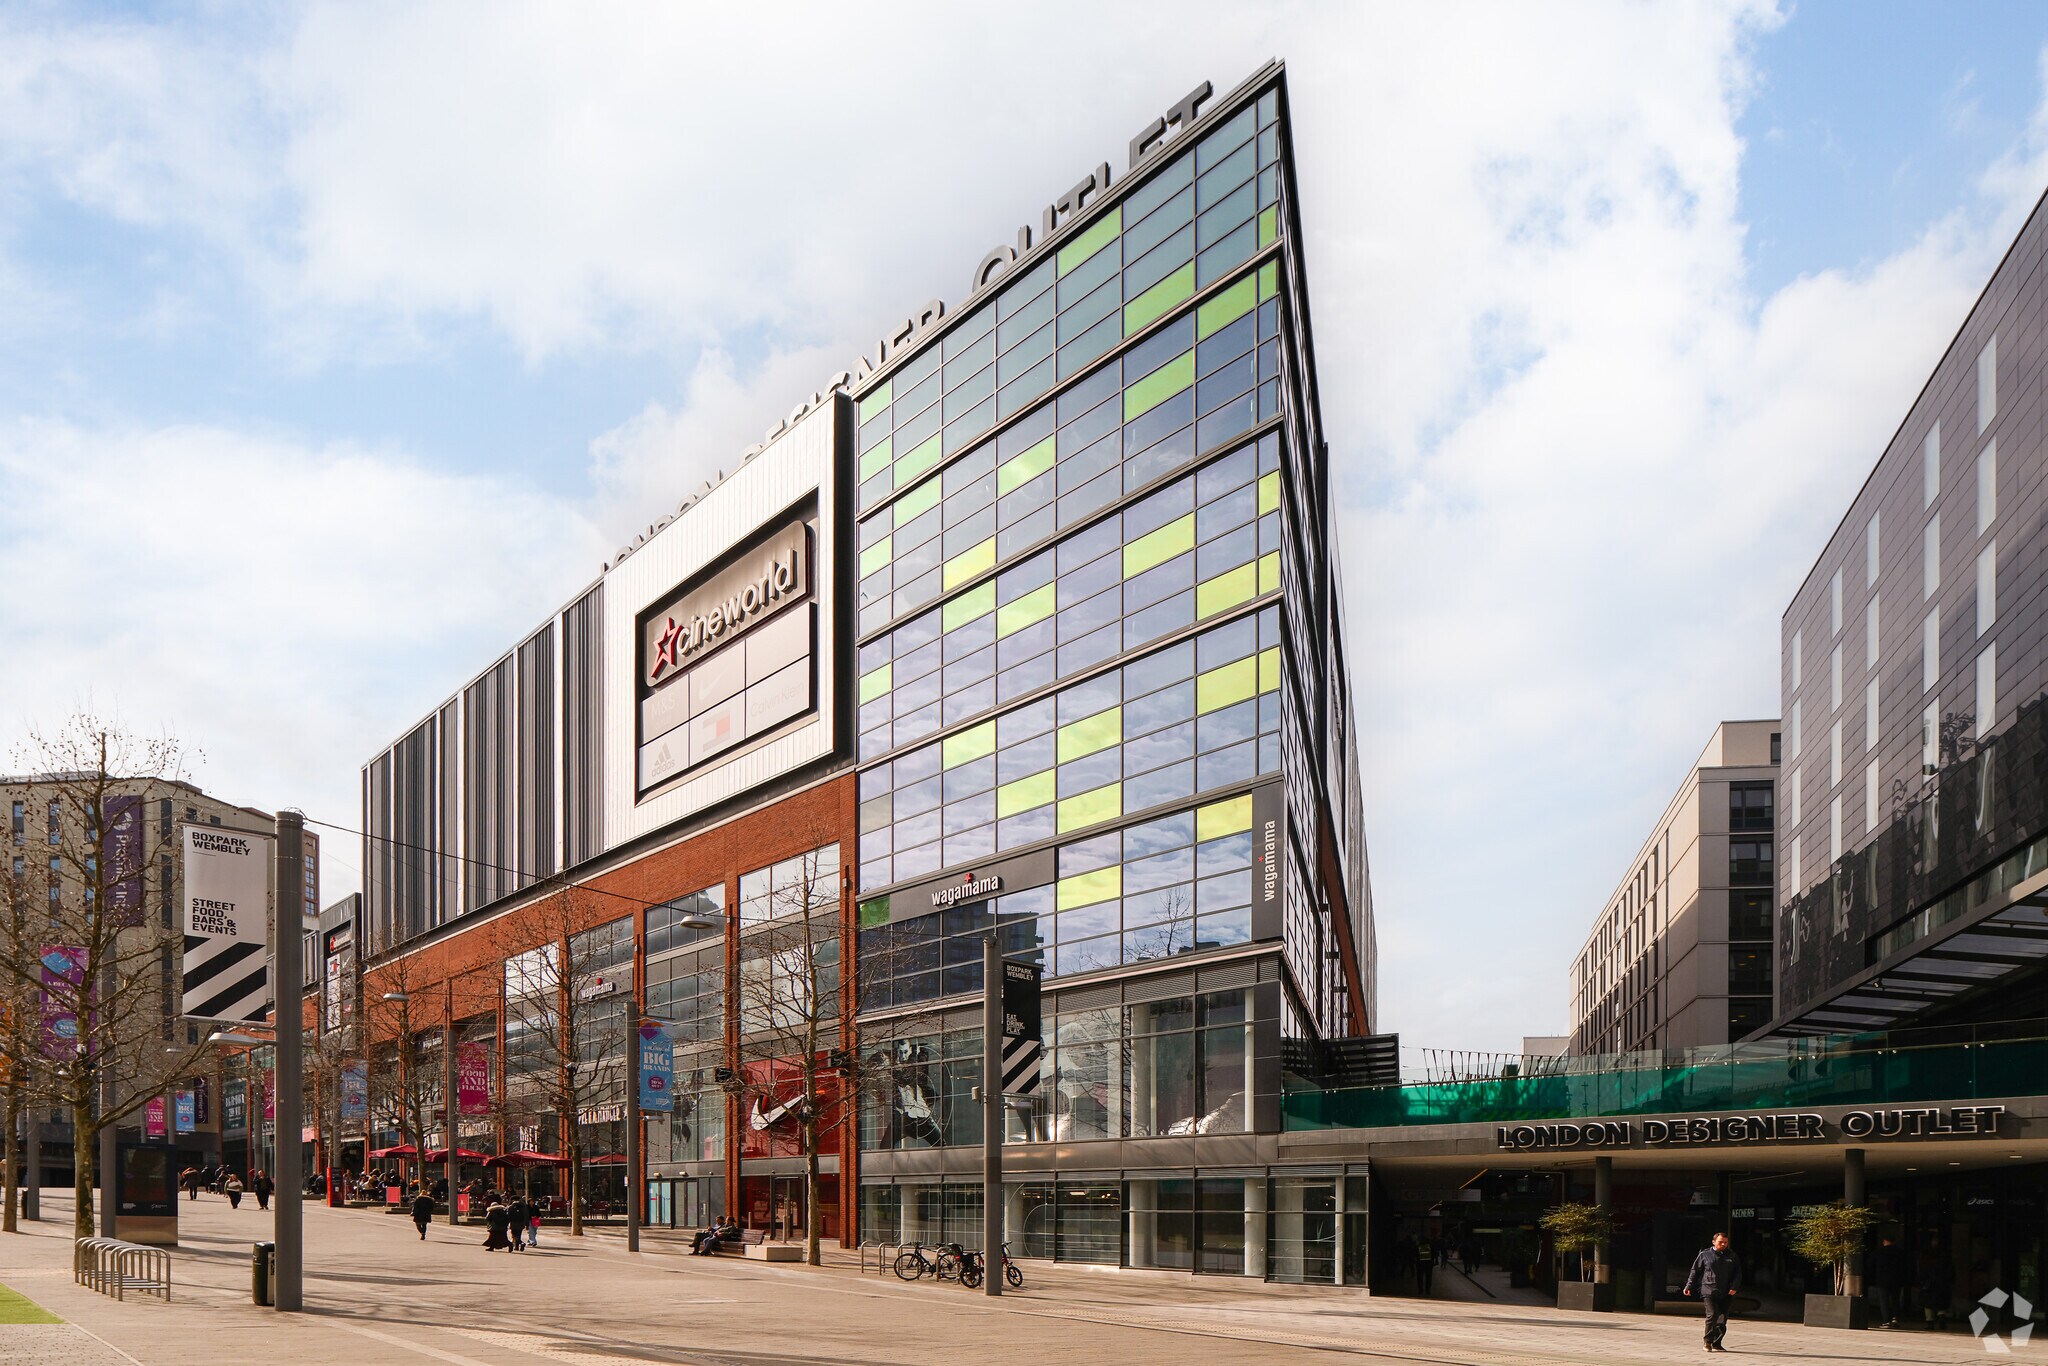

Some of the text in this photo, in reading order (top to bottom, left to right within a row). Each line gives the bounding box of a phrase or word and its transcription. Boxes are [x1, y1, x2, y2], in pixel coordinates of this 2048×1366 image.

[677, 548, 797, 657] cineworld
[750, 695, 780, 718] Calvin
[651, 758, 676, 778] adidas
[192, 831, 248, 848] BOXPARK
[192, 840, 251, 857] WEMBLEY
[1264, 820, 1278, 902] wagamama
[932, 875, 999, 906] wagamama
[192, 897, 237, 912] STREET
[192, 906, 228, 920] FOOD,
[192, 914, 237, 928] BARS &
[192, 922, 238, 936] EVENTS
[1007, 965, 1033, 976] BOXPARK
[1007, 971, 1034, 981] WEMBLEY
[643, 1051, 671, 1067] BIG
[460, 1069, 486, 1078] FOOD
[643, 1063, 672, 1073] BRANDS
[462, 1077, 486, 1086] AND
[1497, 1104, 2006, 1150] LONDON DESIGNER OUTLET
[1731, 1207, 1756, 1219] KECHERS
